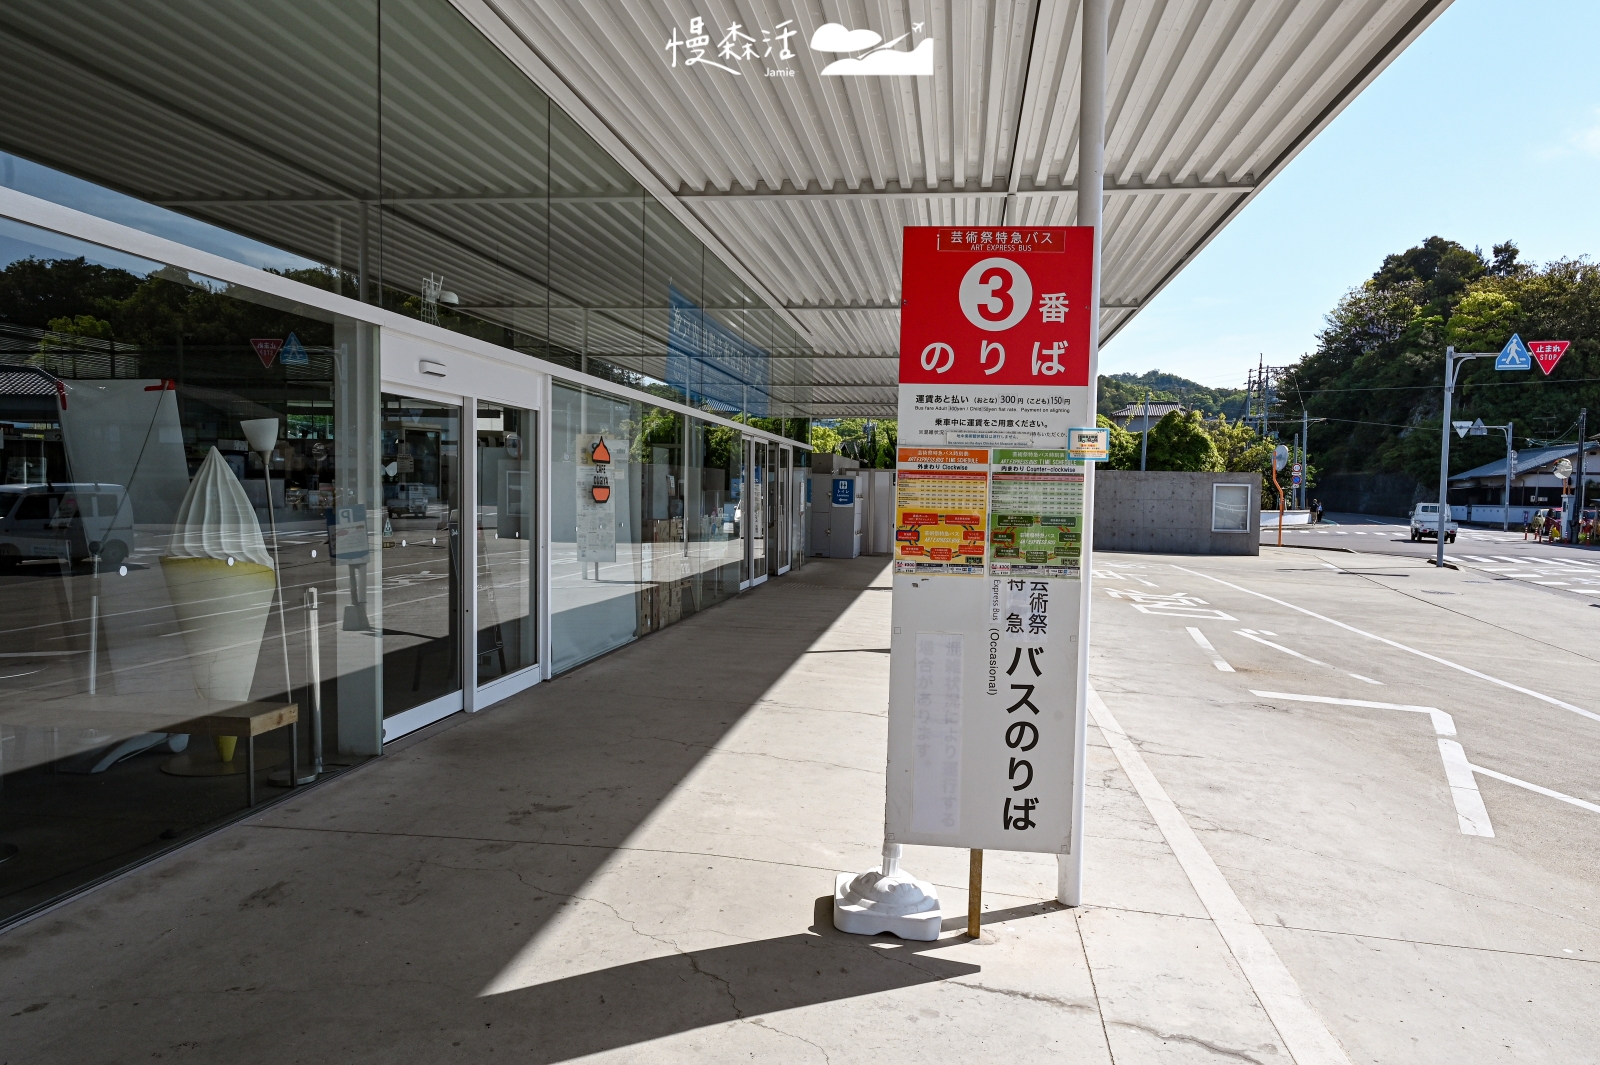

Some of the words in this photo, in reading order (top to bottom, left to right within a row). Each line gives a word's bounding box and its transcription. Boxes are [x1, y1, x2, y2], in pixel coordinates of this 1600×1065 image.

[951, 231, 1053, 244] 芸術祭特急バス
[1536, 345, 1561, 353] 止まれ
[921, 340, 1069, 376] のりば
[916, 395, 969, 404] 運賃あと払い
[935, 418, 1048, 428] 乗車中に運賃をご用意ください。
[991, 579, 1001, 607] Express
[992, 608, 1001, 621] Bus
[987, 628, 1000, 696] (Occasional)
[1003, 646, 1045, 831] バスのりば
